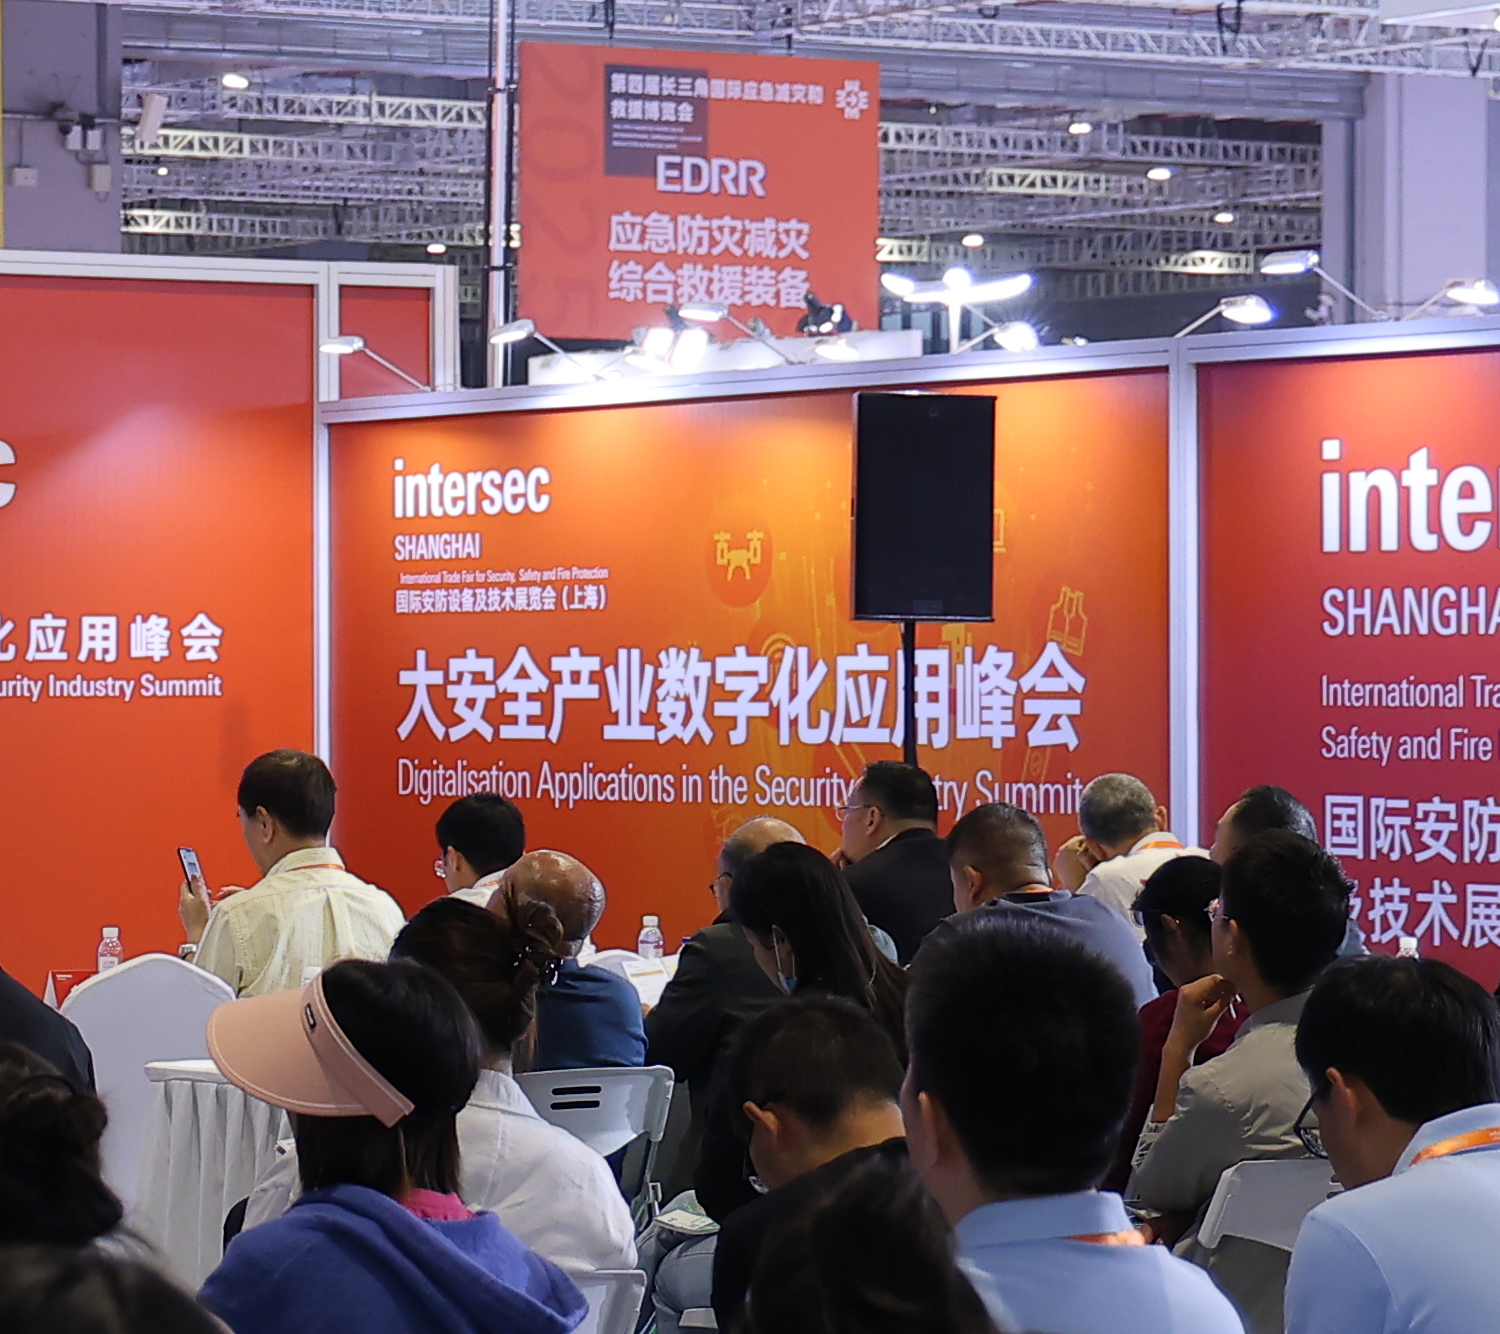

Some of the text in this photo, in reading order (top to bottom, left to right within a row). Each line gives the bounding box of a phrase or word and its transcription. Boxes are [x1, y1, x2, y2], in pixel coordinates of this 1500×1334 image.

[656, 155, 766, 197] EDRR
[609, 211, 811, 260] 应急防灾减灾
[608, 260, 810, 308] 综合救援装备
[394, 458, 550, 518] intersec
[394, 533, 482, 560] SHANGHAI
[400, 572, 441, 585] International
[442, 571, 461, 584] Trade
[461, 570, 474, 583] Fair
[475, 570, 486, 583] for
[518, 568, 541, 584] Safety
[542, 568, 556, 581] and
[557, 567, 571, 581] Fire
[571, 566, 609, 580] Protection
[47, 673, 135, 703] Industry
[140, 673, 222, 697] Summit
[397, 641, 1087, 752] 大安全产业数字化应用峰会
[1320, 675, 1464, 710] International
[1320, 726, 1392, 767] Safety
[1398, 728, 1442, 762] and
[1449, 728, 1492, 762] Fire
[397, 758, 534, 800] Digitalisation
[539, 760, 674, 810] Applications
[682, 762, 703, 801] in
[709, 763, 748, 803] the
[753, 764, 857, 809] Security
[975, 770, 1084, 813] Summit
